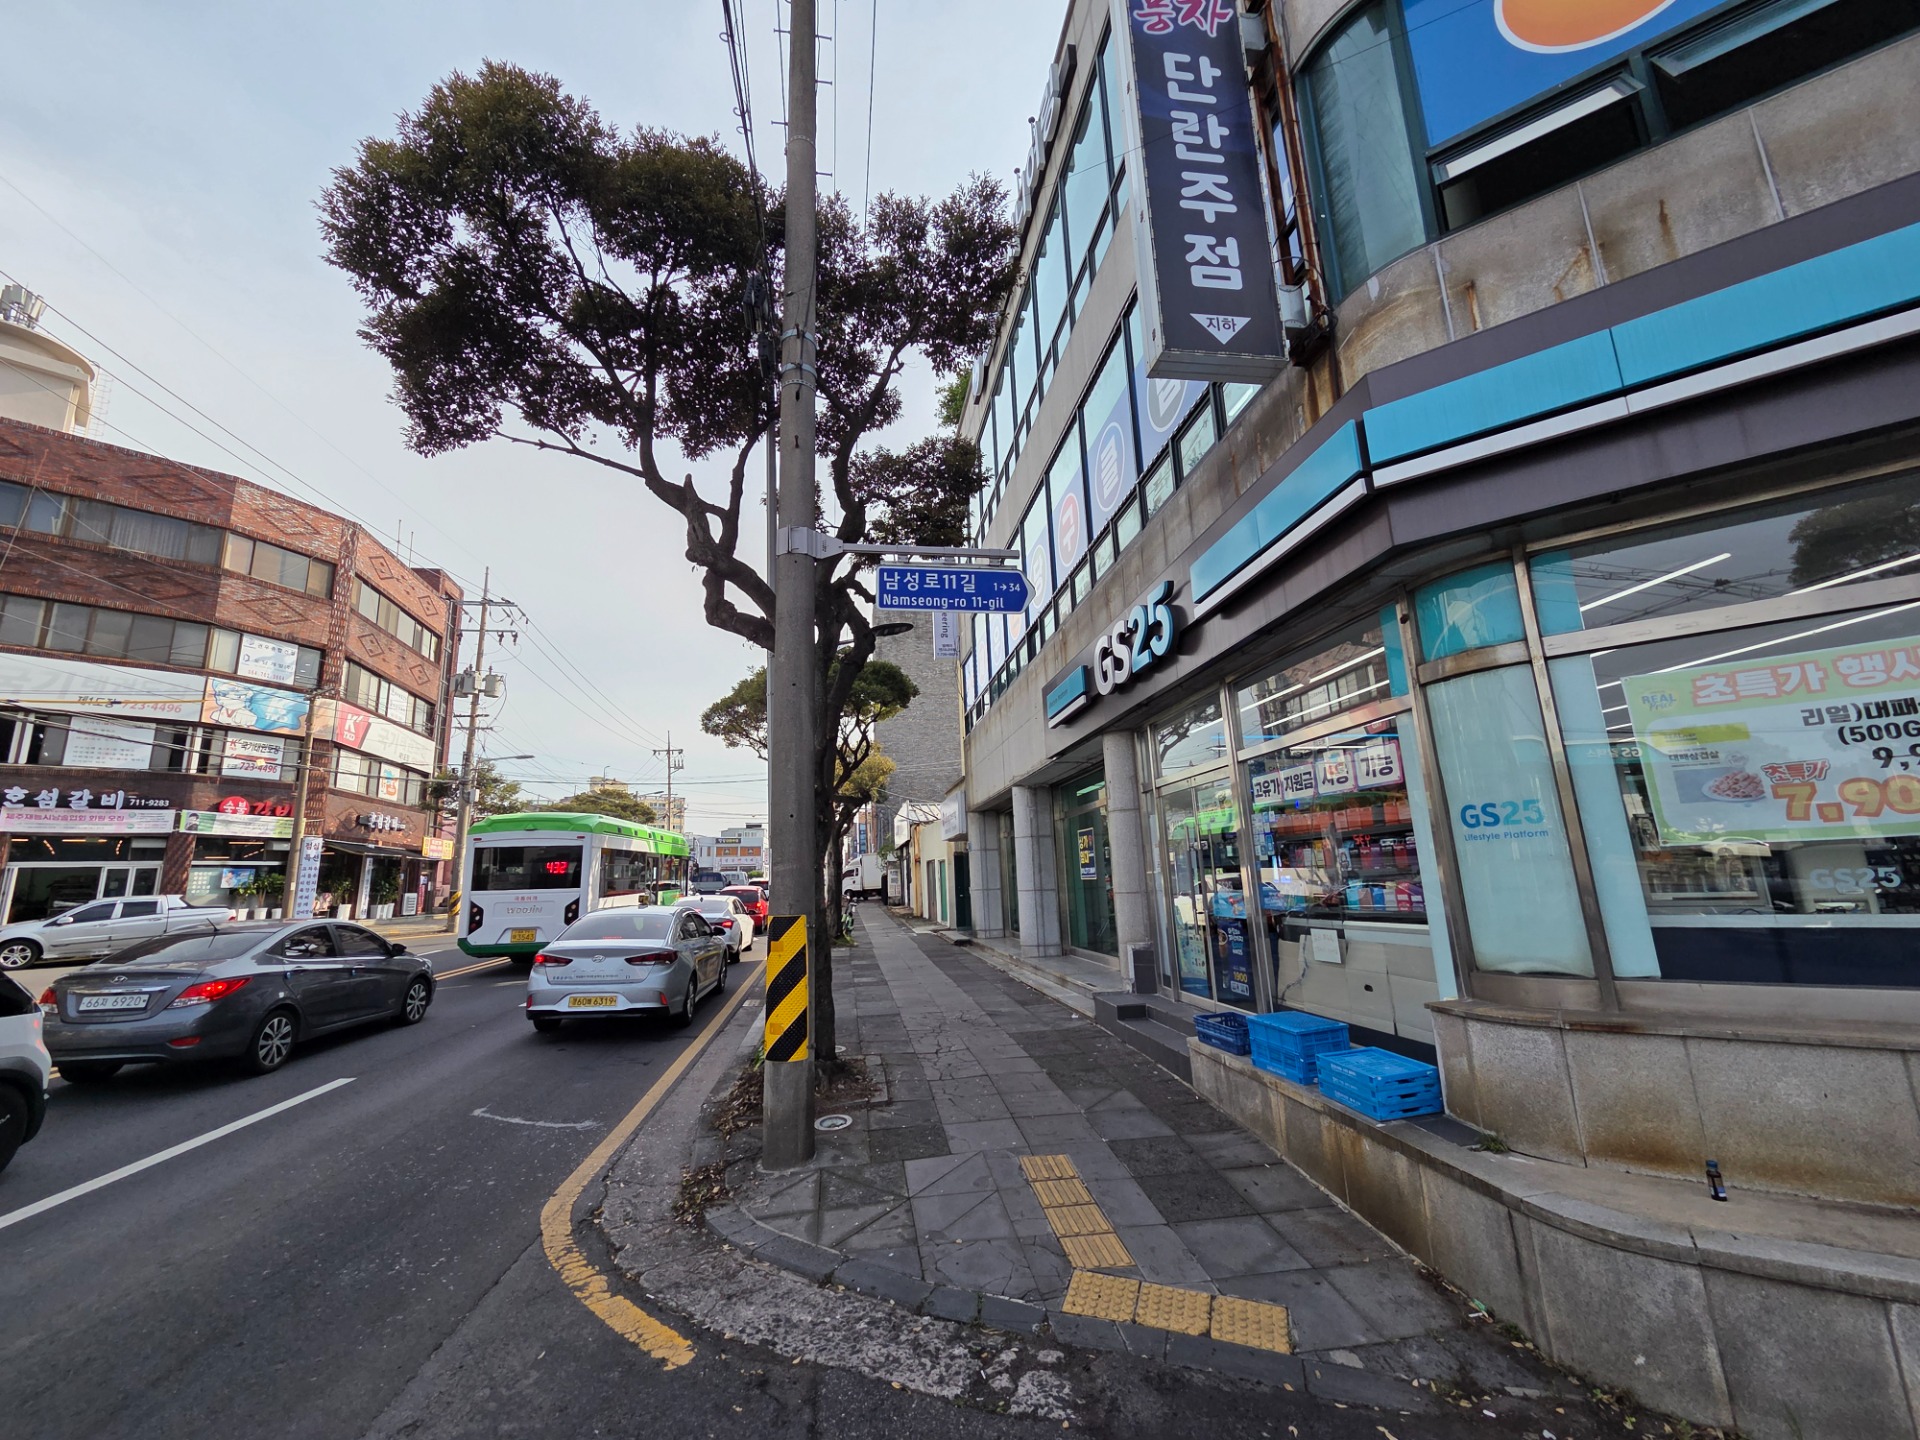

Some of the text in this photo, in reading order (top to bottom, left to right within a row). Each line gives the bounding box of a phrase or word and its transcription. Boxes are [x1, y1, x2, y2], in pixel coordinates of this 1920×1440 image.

[1163, 51, 1243, 291] 단란주점
[1206, 317, 1237, 333] 지하
[883, 572, 976, 593] 남성로11길
[883, 594, 1004, 610] Namseong-ro 11-gil
[1094, 580, 1175, 695] GS25
[1691, 660, 1829, 707] 초특가
[1641, 694, 1677, 705] REAL
[1668, 750, 1720, 762] 대패삼겹살
[1762, 758, 1830, 784] 초특가
[1254, 778, 1280, 798] 고유가
[1284, 771, 1314, 792] 지원금
[129, 799, 169, 807] 711-9283
[1461, 798, 1546, 829] GS25
[1464, 829, 1549, 842] Lifestyle Platform
[546, 861, 568, 874] 432
[1809, 866, 1901, 889] GS25
[112, 997, 142, 1006] 6920
[593, 997, 614, 1006] 6319
